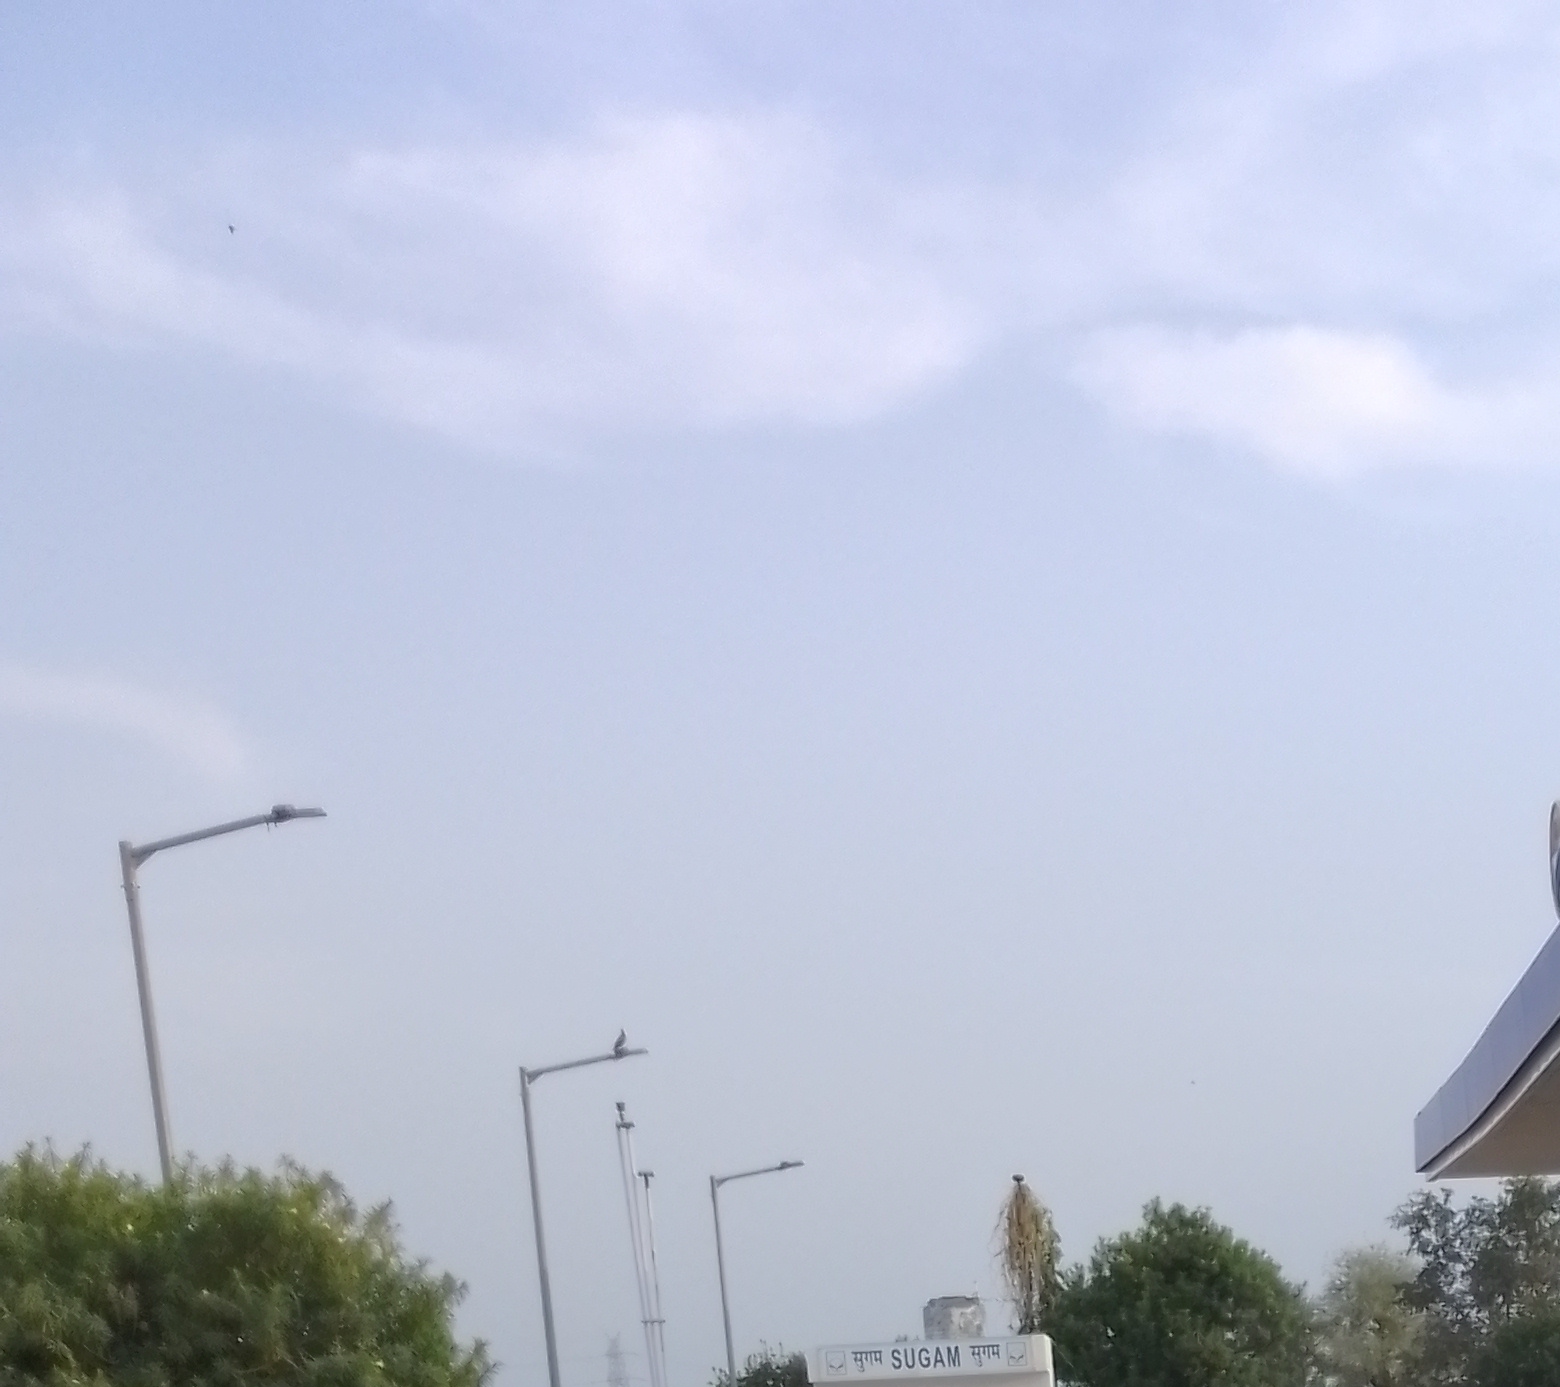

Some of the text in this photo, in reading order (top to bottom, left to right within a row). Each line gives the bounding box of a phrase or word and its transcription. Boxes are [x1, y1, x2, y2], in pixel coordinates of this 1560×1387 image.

[851, 1344, 1000, 1373] सुगम SUGAM सुगम
